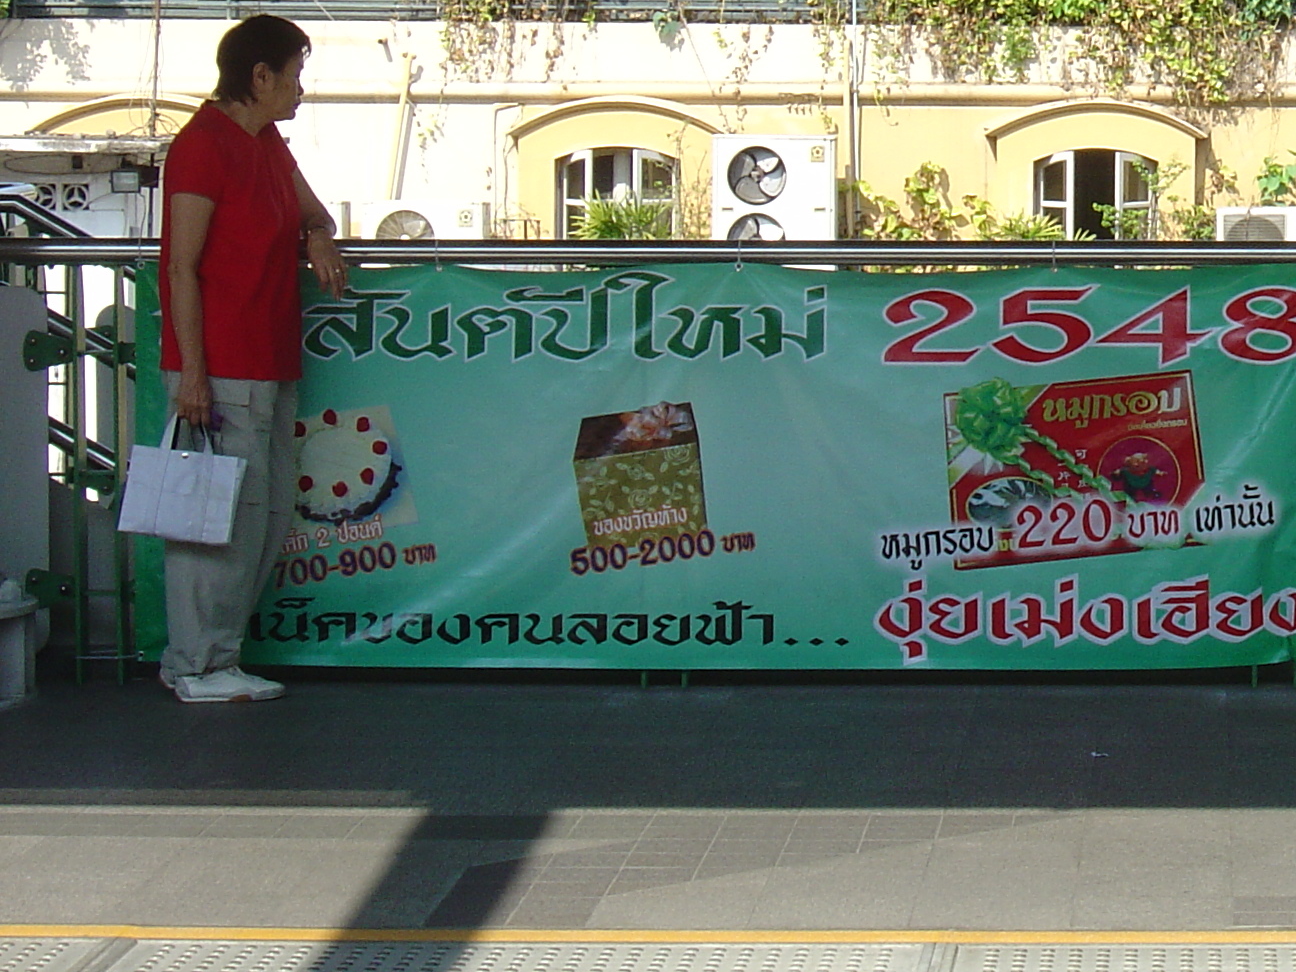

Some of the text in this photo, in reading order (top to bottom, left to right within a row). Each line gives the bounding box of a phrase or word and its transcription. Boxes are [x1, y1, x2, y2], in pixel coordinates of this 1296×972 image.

[1042, 387, 1182, 429] หมูกรอบ
[316, 527, 332, 549] 2
[881, 483, 1275, 570] หมูกรอบ 220 บาท เท่านั้น
[272, 542, 437, 589] 700-900 บาท
[570, 528, 756, 576] 500-2000 บาท
